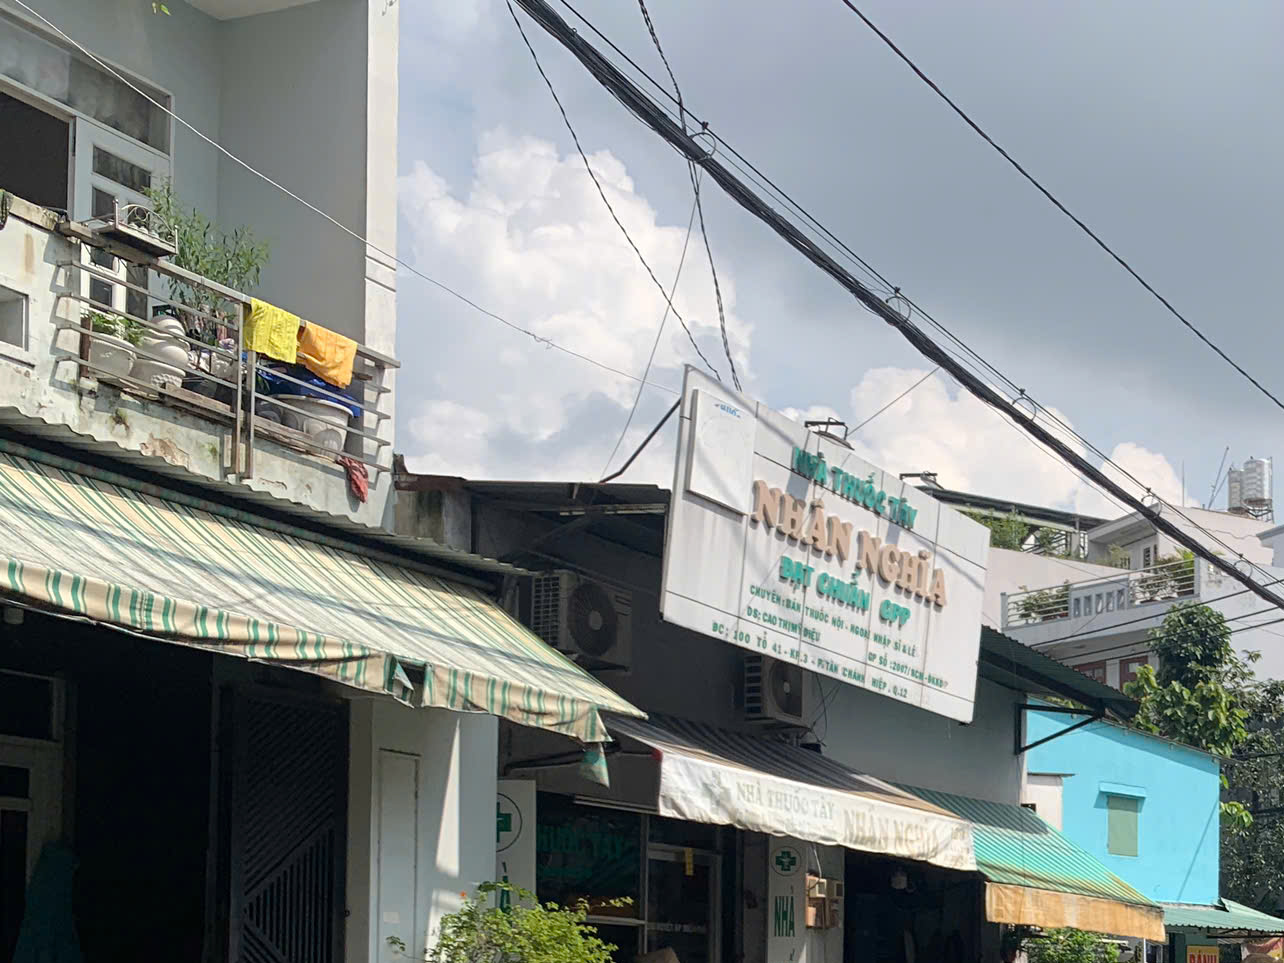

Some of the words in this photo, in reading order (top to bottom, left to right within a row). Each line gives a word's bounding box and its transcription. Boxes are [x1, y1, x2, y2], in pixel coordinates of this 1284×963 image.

[750, 480, 853, 562] NHÂN
[856, 530, 947, 607] NGHĨA
[762, 612, 778, 626] CAO
[733, 630, 751, 644] 100
[774, 885, 796, 937] NHÀ
